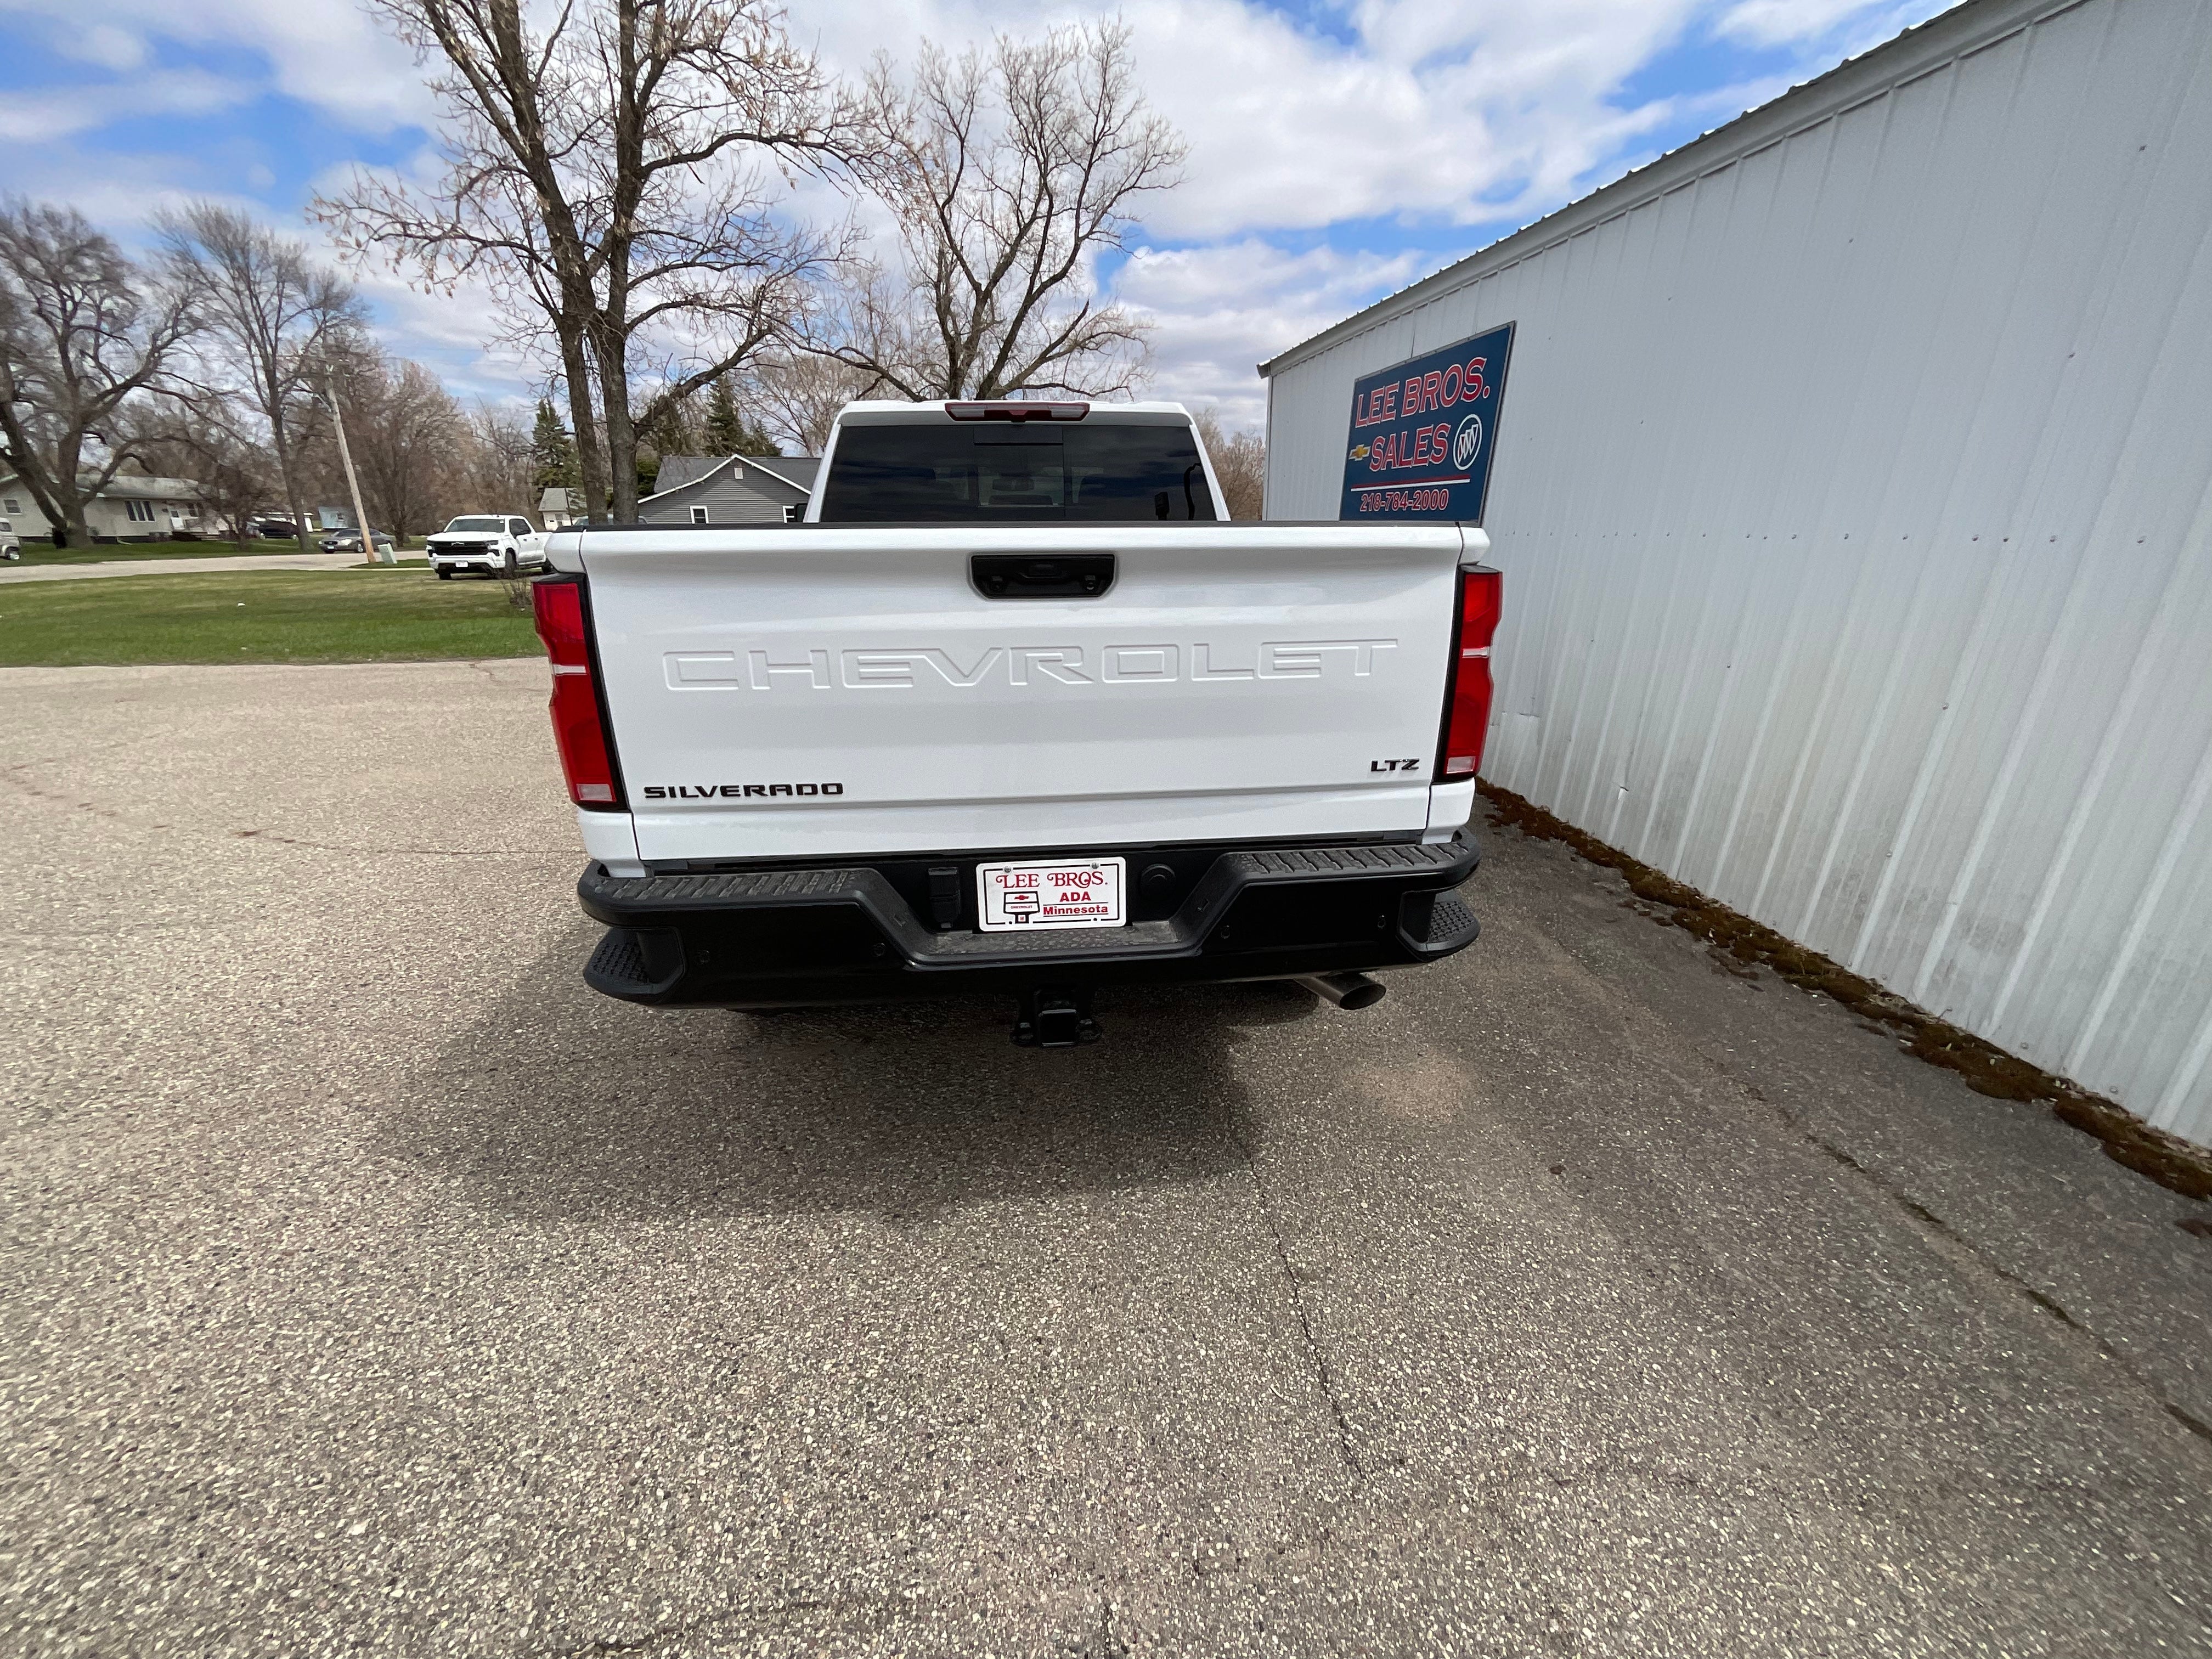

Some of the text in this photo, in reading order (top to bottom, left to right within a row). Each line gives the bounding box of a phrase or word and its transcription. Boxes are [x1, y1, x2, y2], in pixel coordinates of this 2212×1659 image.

[1356, 357, 1490, 428] LEE BROS.
[1370, 423, 1451, 471] SALES
[1360, 489, 1449, 511] 218-784-2000
[662, 637, 1398, 691] CHEVROLET
[1370, 757, 1420, 772] LTZ
[644, 782, 844, 800] SILVERADO
[996, 871, 1108, 889] LEE BROS.
[1059, 891, 1092, 902] ADA
[1043, 905, 1108, 915] Minnesota
